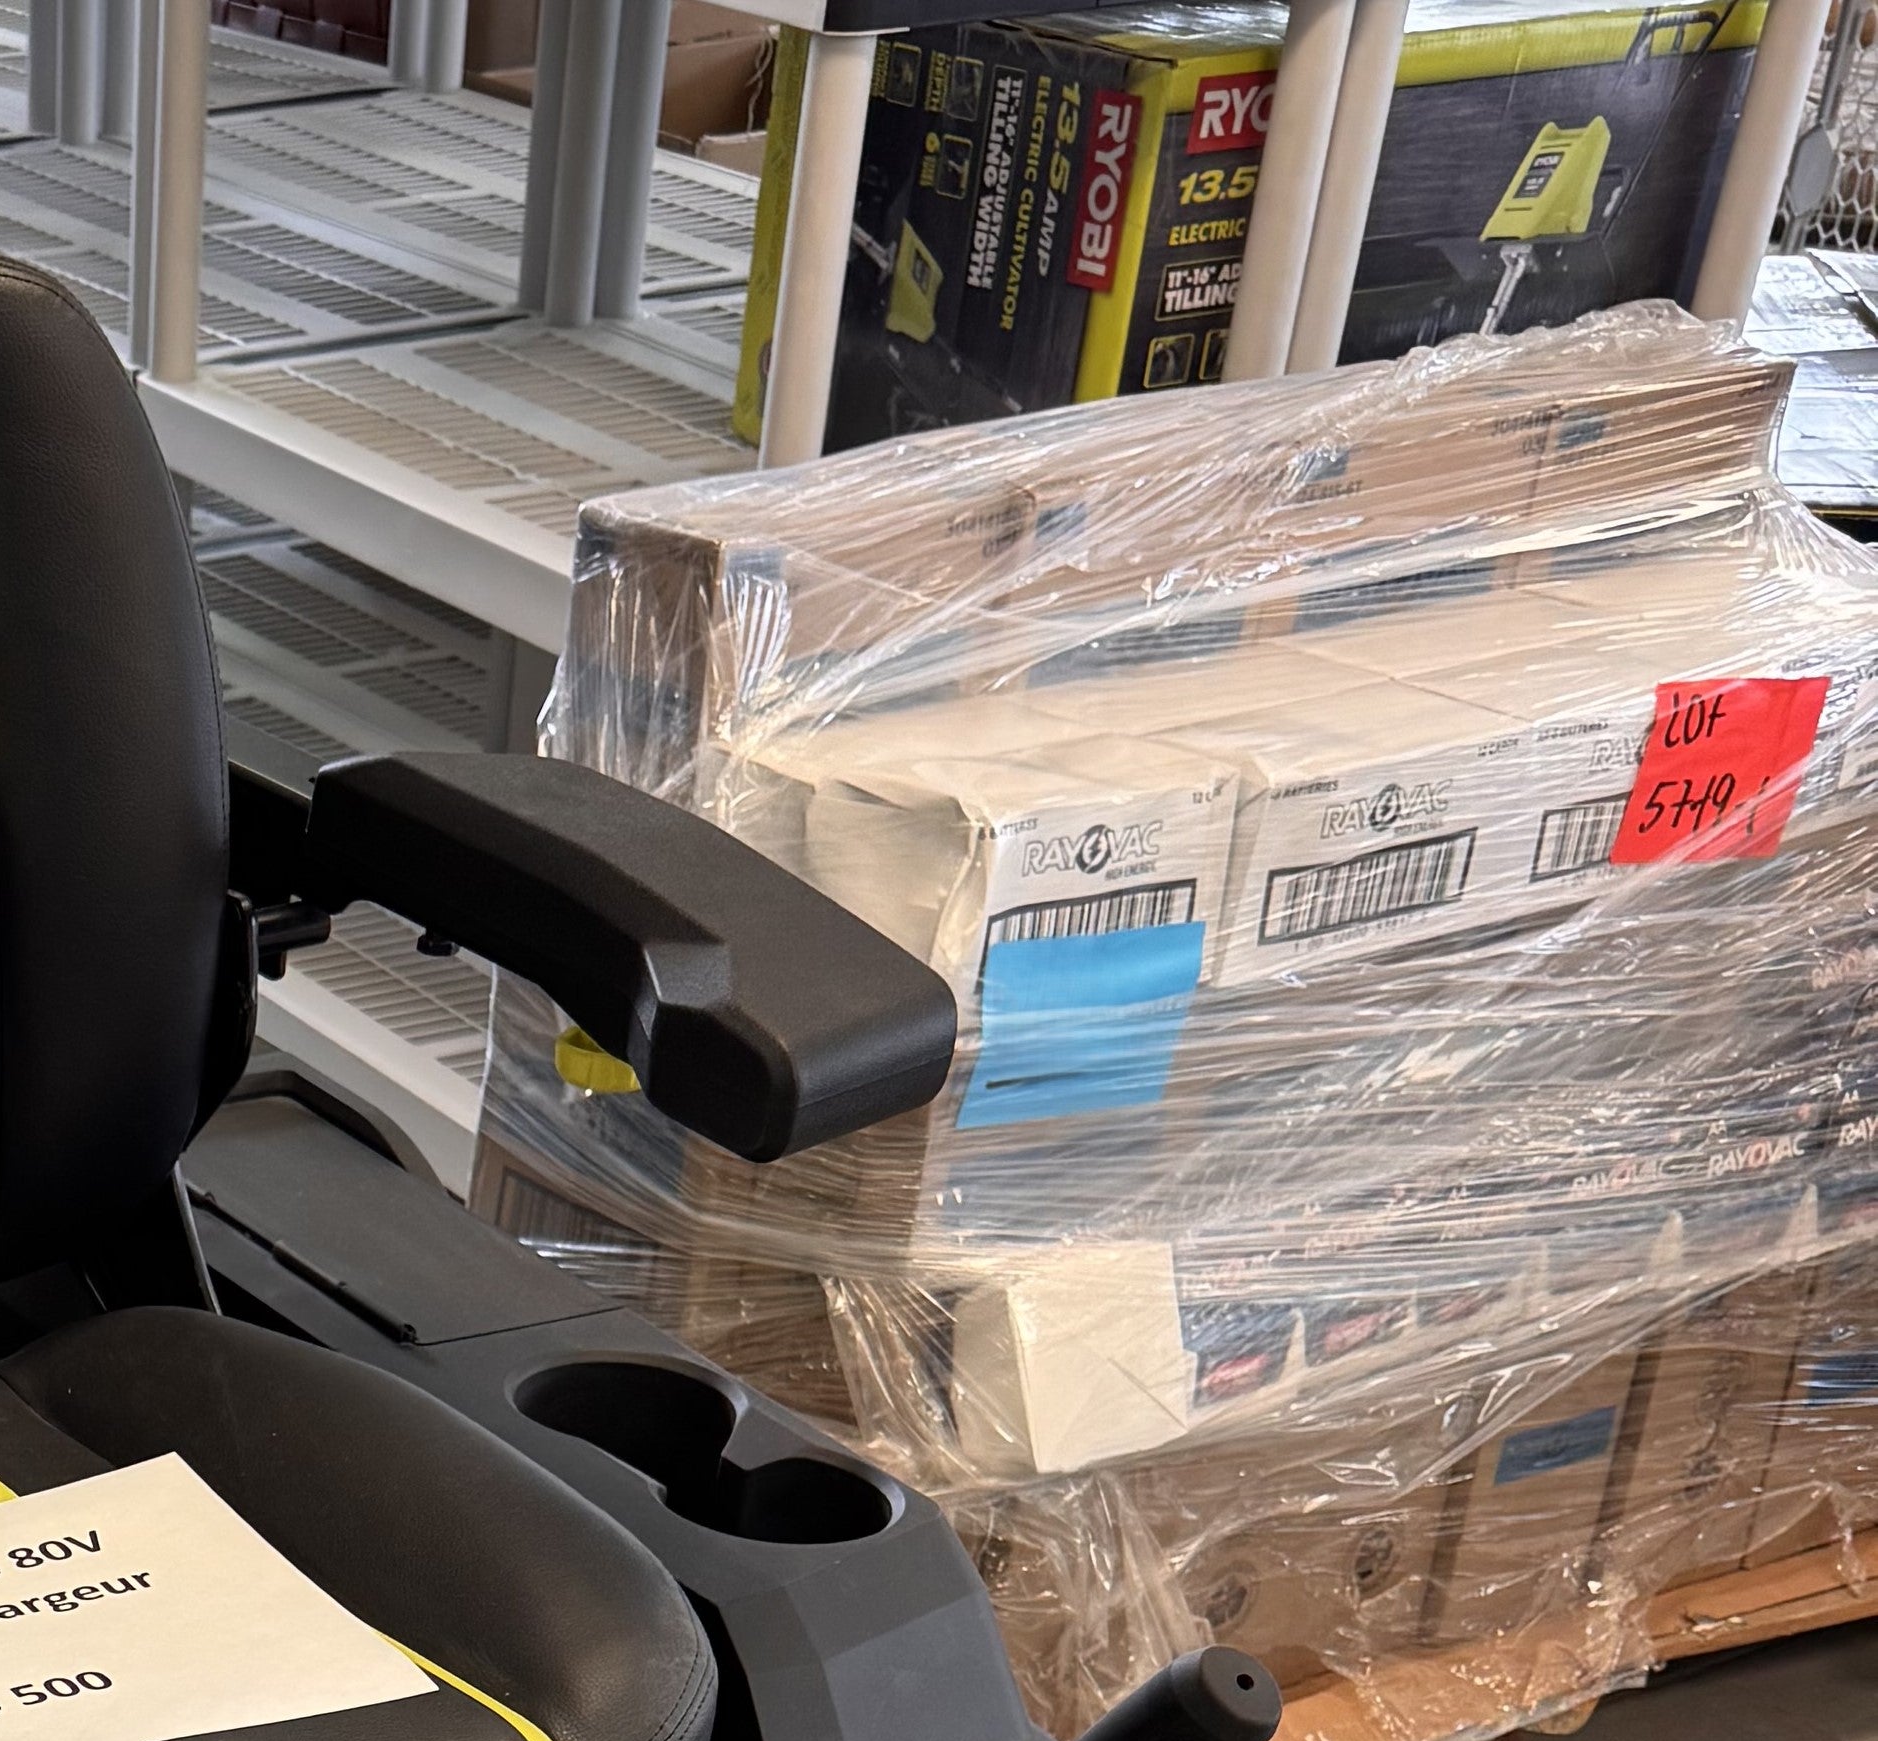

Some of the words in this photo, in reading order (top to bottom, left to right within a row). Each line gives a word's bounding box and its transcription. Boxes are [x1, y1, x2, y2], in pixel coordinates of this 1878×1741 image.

[984, 76, 1012, 196] TILLING
[1024, 75, 1052, 182] ELECTRIC
[981, 152, 1012, 290] ADJUSTABLE
[1076, 103, 1133, 277] RYOBI
[1178, 165, 1260, 206] 13.5
[966, 195, 996, 289] WIDTH
[999, 187, 1034, 331] CULTIVATOR
[1168, 217, 1246, 246] ELECTRIC
[1022, 820, 1164, 878] RAYOVAC
[1707, 1131, 1810, 1178] RAYOVAC
[6, 1530, 102, 1569] 80V
[10, 1670, 113, 1705] 500
